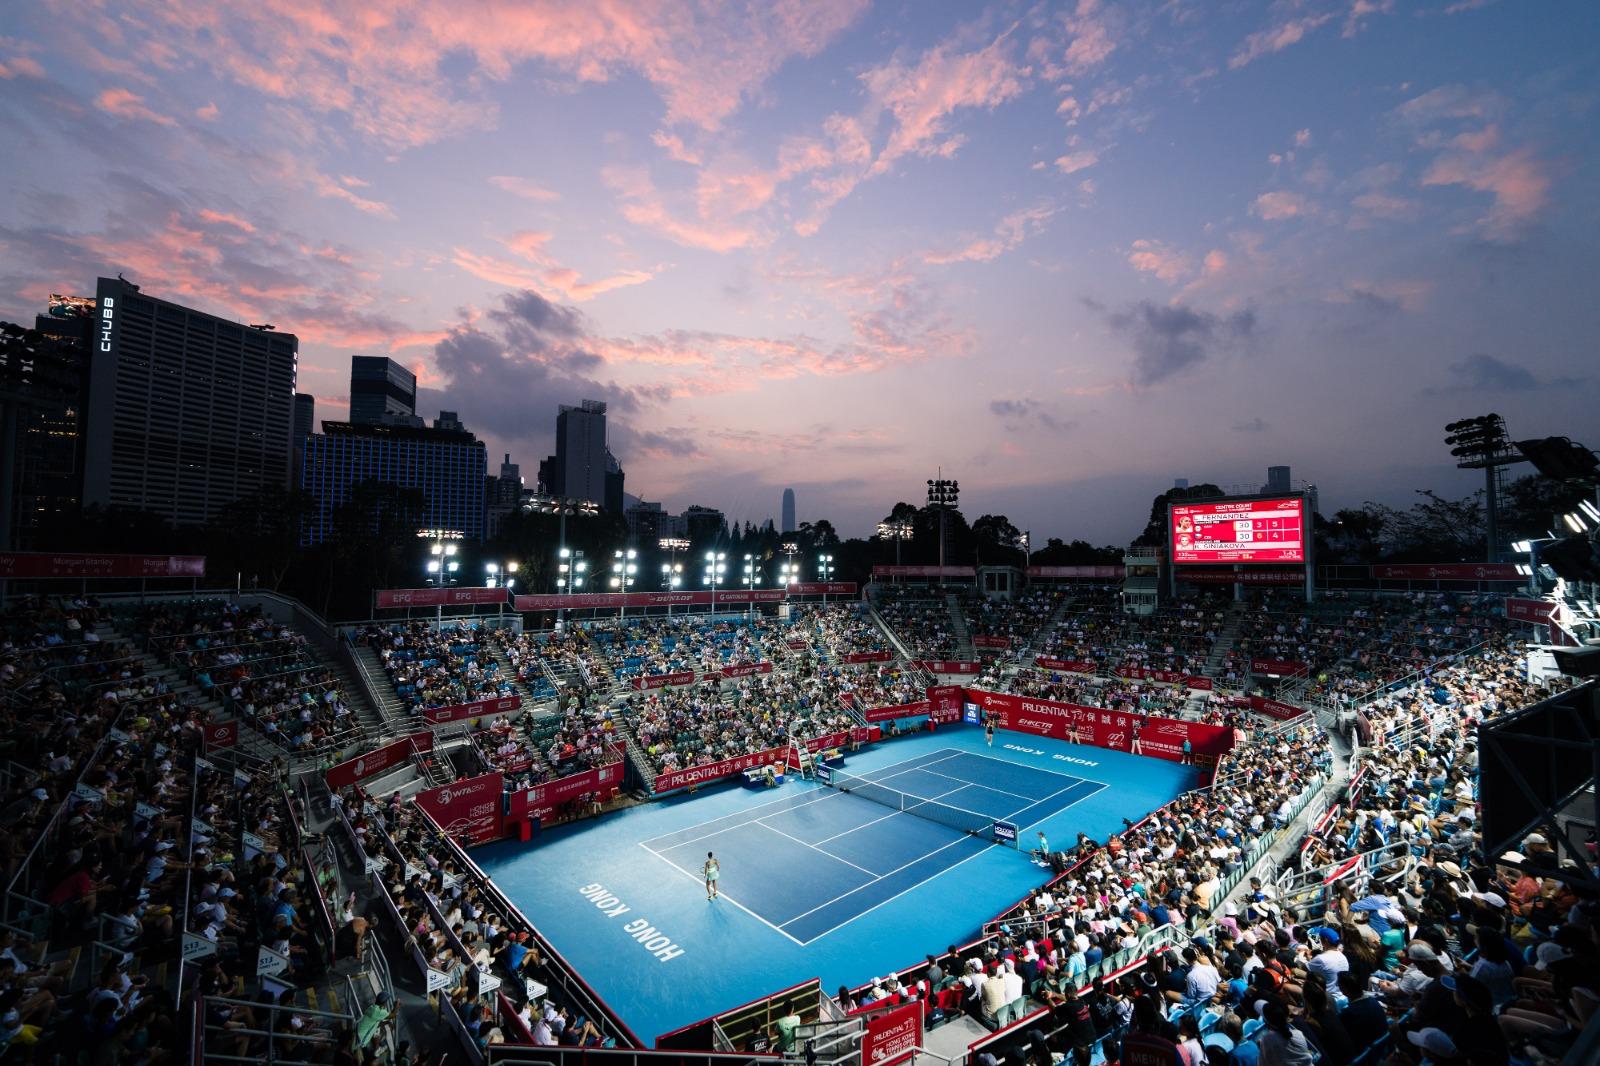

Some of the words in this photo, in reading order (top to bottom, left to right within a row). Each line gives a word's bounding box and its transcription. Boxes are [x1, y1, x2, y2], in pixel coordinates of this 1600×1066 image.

[101, 297, 114, 352] CHUBB
[53, 557, 84, 567] Morgan
[85, 558, 113, 567] Stanley
[393, 593, 411, 603] EFG
[455, 592, 471, 601] EFG
[1254, 662, 1269, 670] EFG
[1021, 702, 1072, 718] PRUDENTIAL
[1003, 744, 1045, 756] KONG
[1052, 753, 1100, 767] HONG
[671, 765, 720, 787] PRUDENTIAL
[452, 783, 485, 798] WTA250
[578, 882, 632, 918] KONG
[623, 918, 686, 962] HONG
[873, 1024, 904, 1043] PRUDENTIAL
[886, 1037, 901, 1048] HONG
[902, 1031, 916, 1043] KONG
